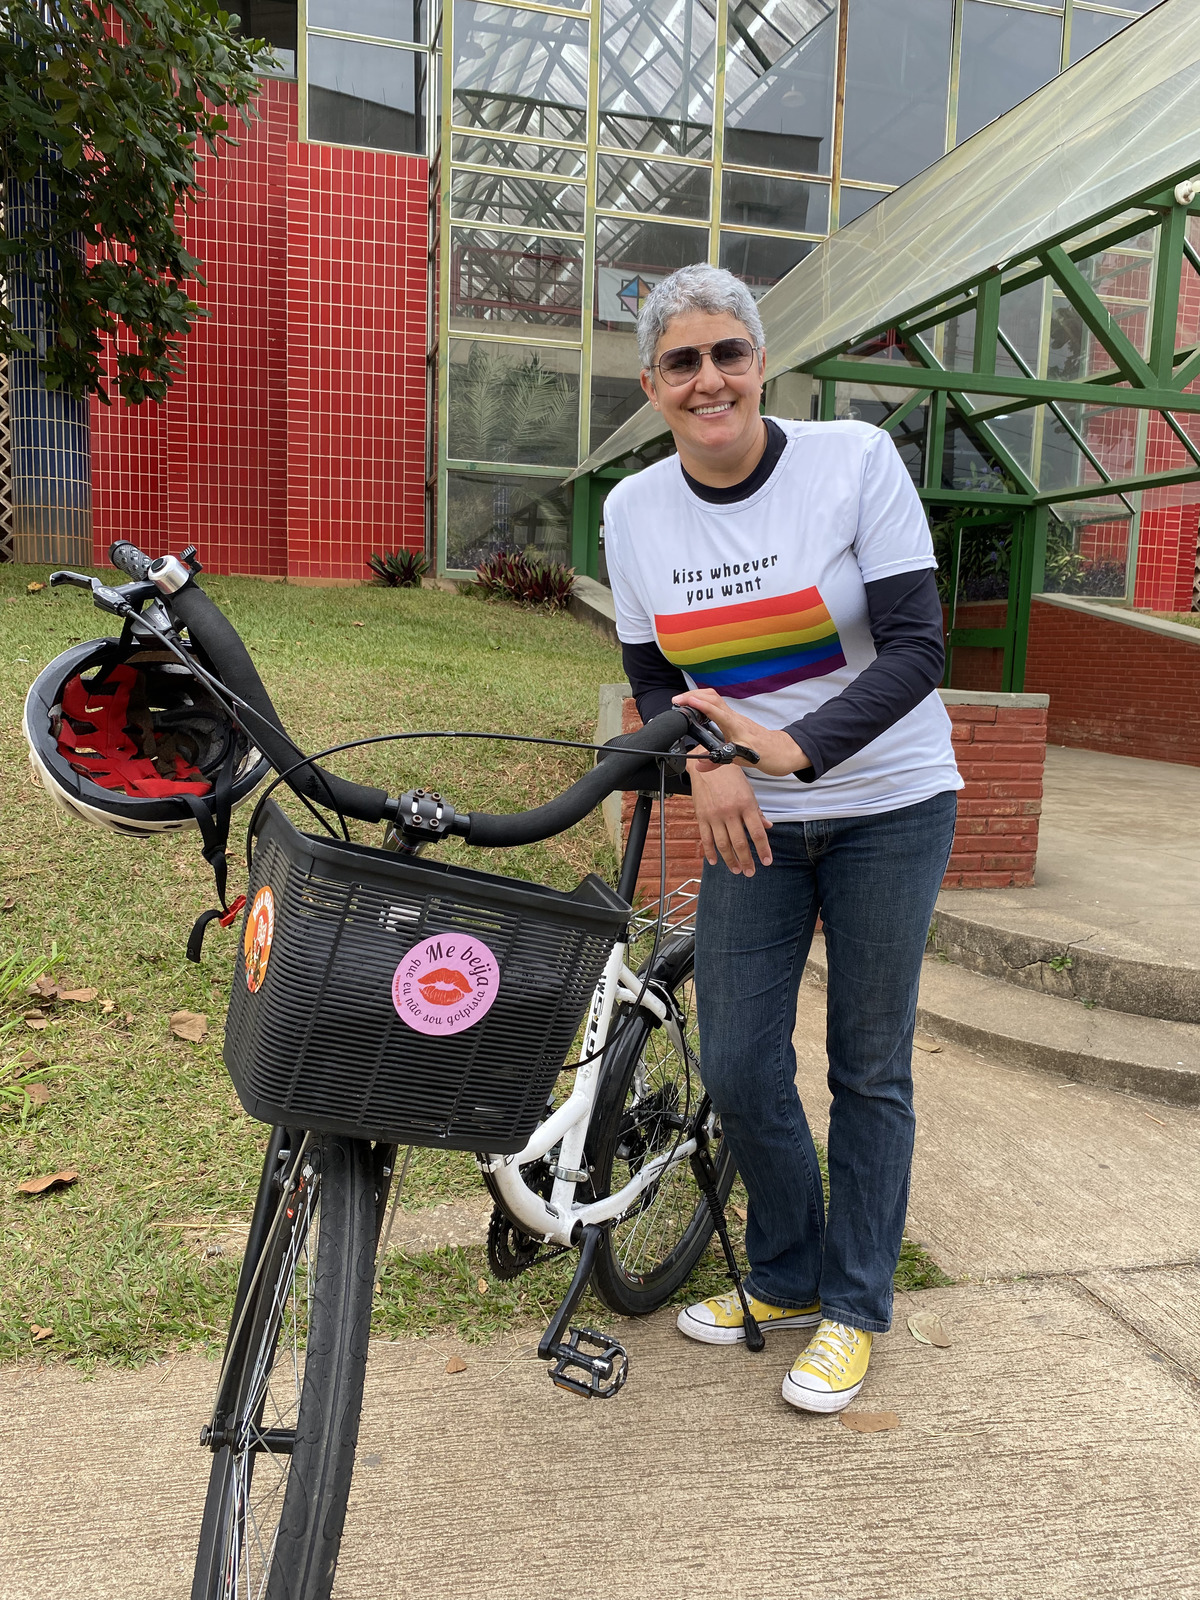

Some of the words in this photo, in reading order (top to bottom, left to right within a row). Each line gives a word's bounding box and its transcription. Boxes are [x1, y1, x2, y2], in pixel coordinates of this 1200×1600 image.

[672, 568, 703, 585] kiss
[710, 554, 779, 580] whoever
[686, 586, 714, 606] you
[721, 576, 763, 598] want
[405, 959, 422, 979] que
[425, 941, 456, 964] Me
[460, 946, 492, 987] beija
[403, 981, 412, 996] eu
[405, 997, 423, 1017] não
[422, 1014, 443, 1025] sou
[446, 990, 486, 1027] golpista
